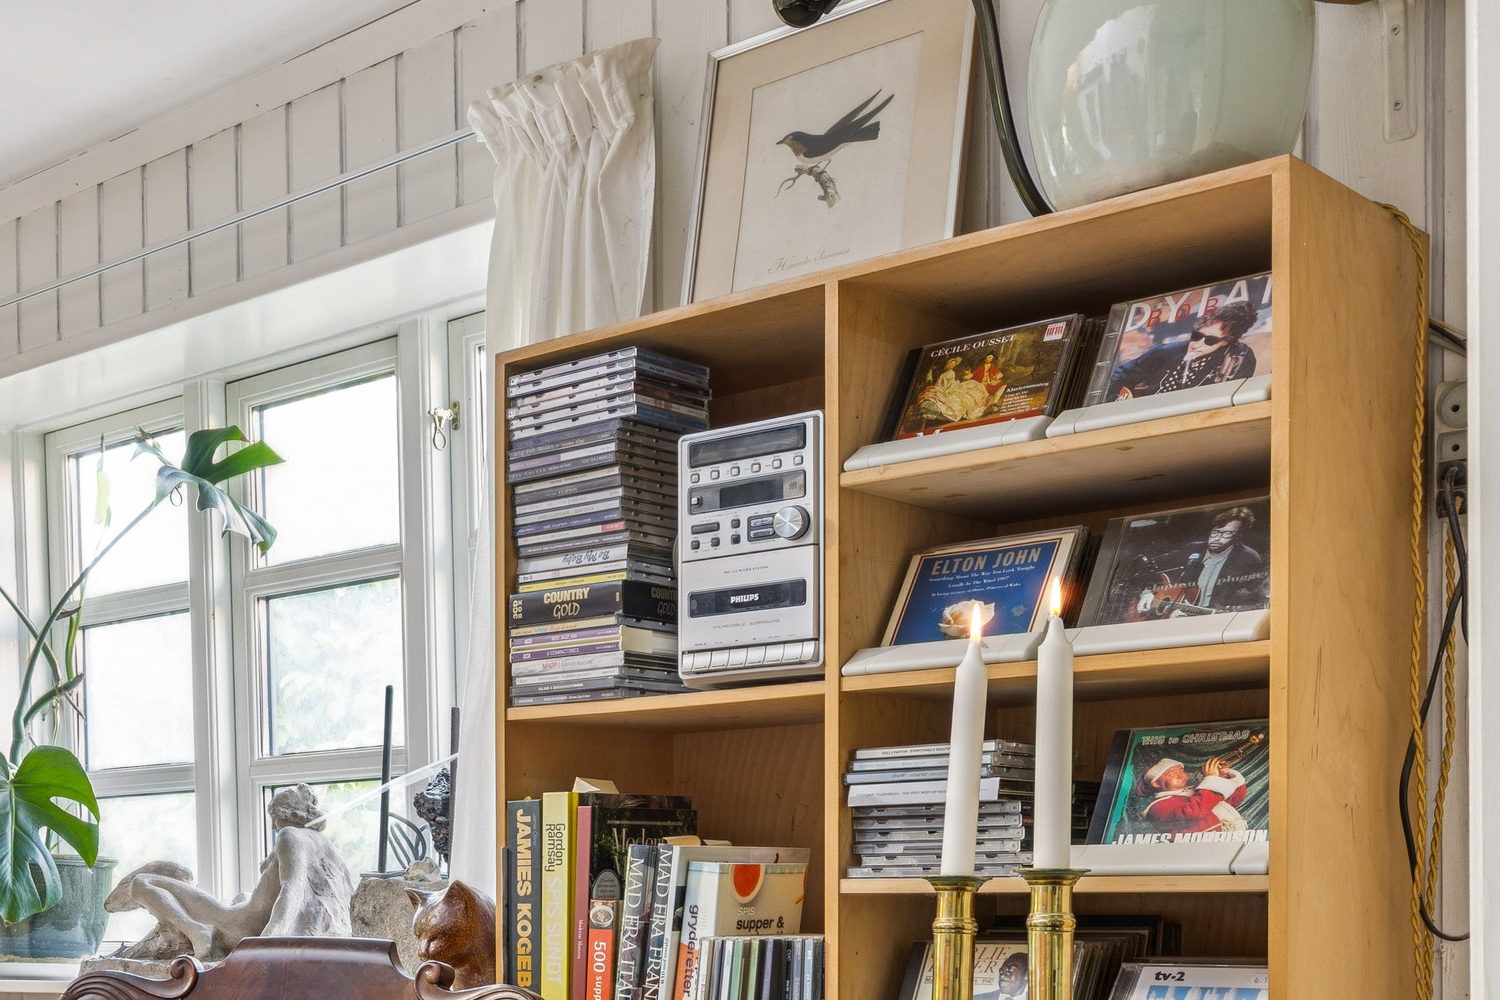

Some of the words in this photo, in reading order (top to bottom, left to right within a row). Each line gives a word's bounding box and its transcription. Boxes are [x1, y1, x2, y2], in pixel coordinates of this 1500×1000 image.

[1147, 298, 1219, 328] BOB
[972, 334, 1016, 349] OUSSET
[931, 555, 987, 576] ELTON
[992, 547, 1042, 568] JOHN
[543, 587, 590, 604] COUNTRY
[553, 602, 581, 618] GOLD
[730, 593, 759, 603] PHILIPS
[1142, 735, 1166, 746] THIS
[1182, 730, 1250, 744] CHRISTMAS
[516, 809, 532, 896] JAMIES
[544, 823, 555, 872] Ramsay
[556, 823, 565, 866] Gordon
[1112, 833, 1172, 844] JAMES
[1174, 830, 1268, 843] MORRISON
[626, 857, 645, 908] MAD
[656, 848, 673, 898] MAD
[546, 877, 564, 918] SPIS
[737, 907, 756, 916] SPIS
[622, 913, 639, 953] FRA
[650, 904, 668, 939] FRA
[736, 917, 774, 932] supper
[777, 916, 784, 929] &
[516, 903, 532, 988] KOGEB
[546, 920, 563, 985] SUNDT
[593, 941, 607, 972] 500
[684, 905, 699, 998] gryderetter
